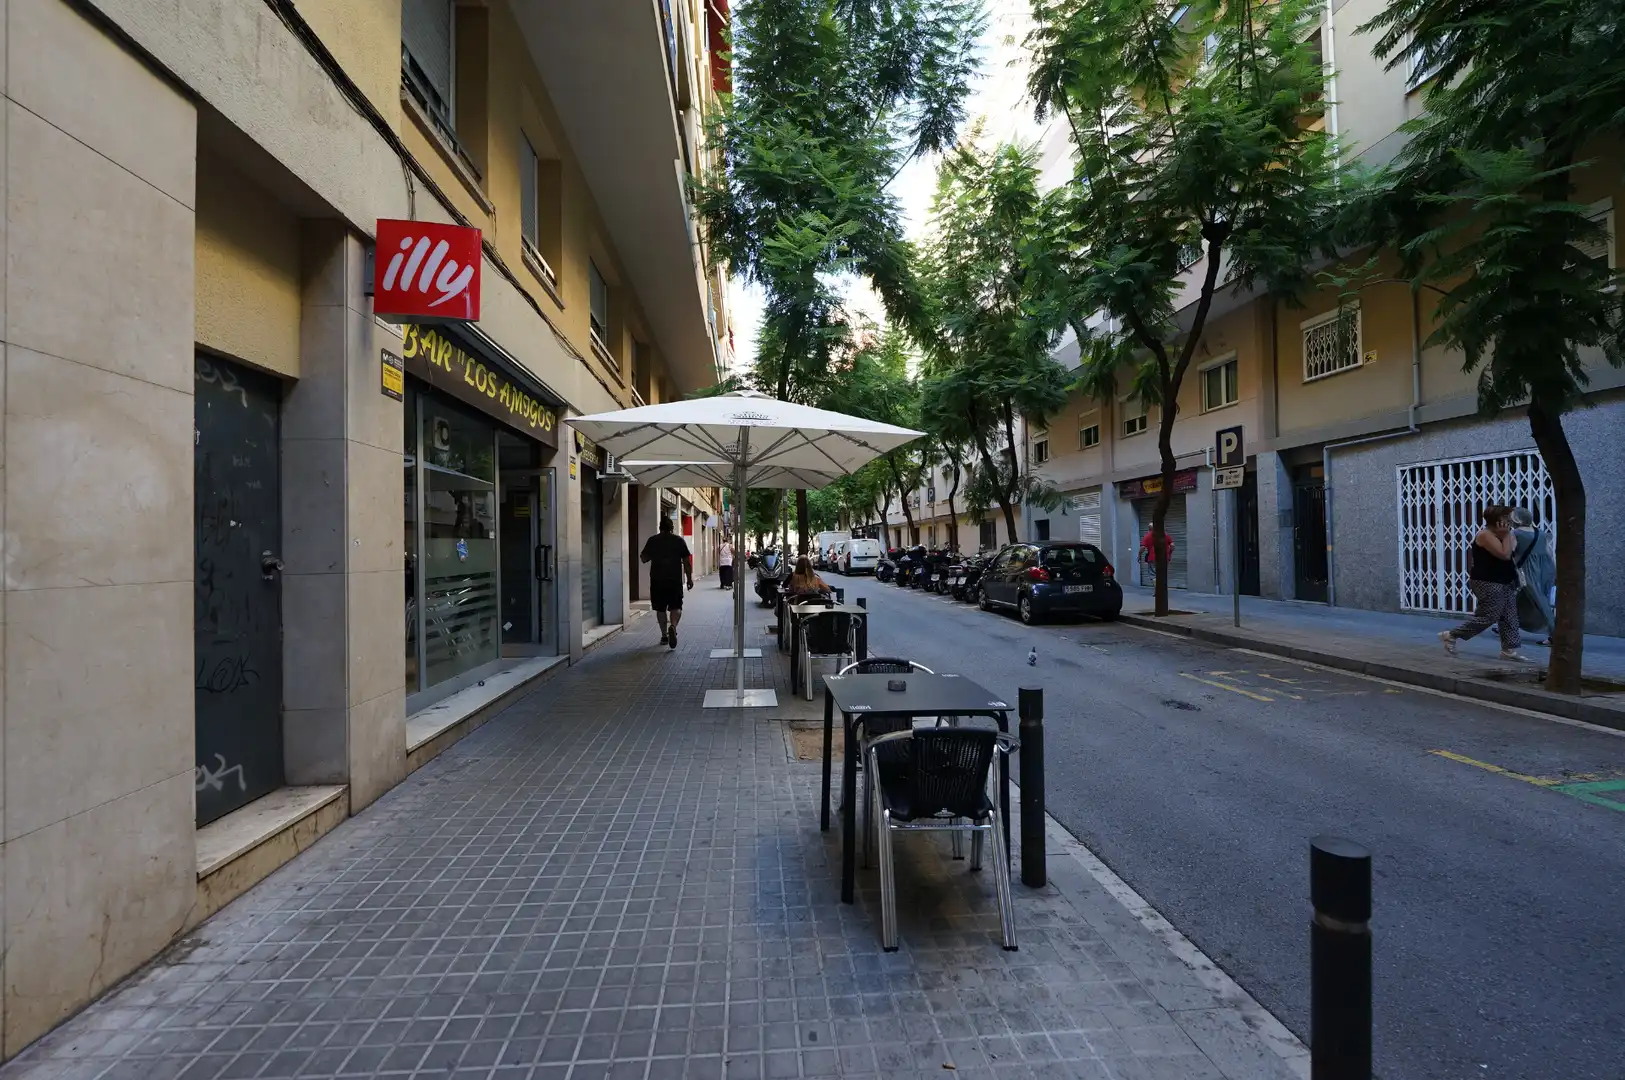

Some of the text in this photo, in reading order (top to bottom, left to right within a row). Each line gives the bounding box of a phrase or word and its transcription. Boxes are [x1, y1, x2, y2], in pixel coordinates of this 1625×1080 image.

[382, 236, 475, 307] illy
[404, 324, 452, 372] BAR
[1221, 432, 1237, 464] P
